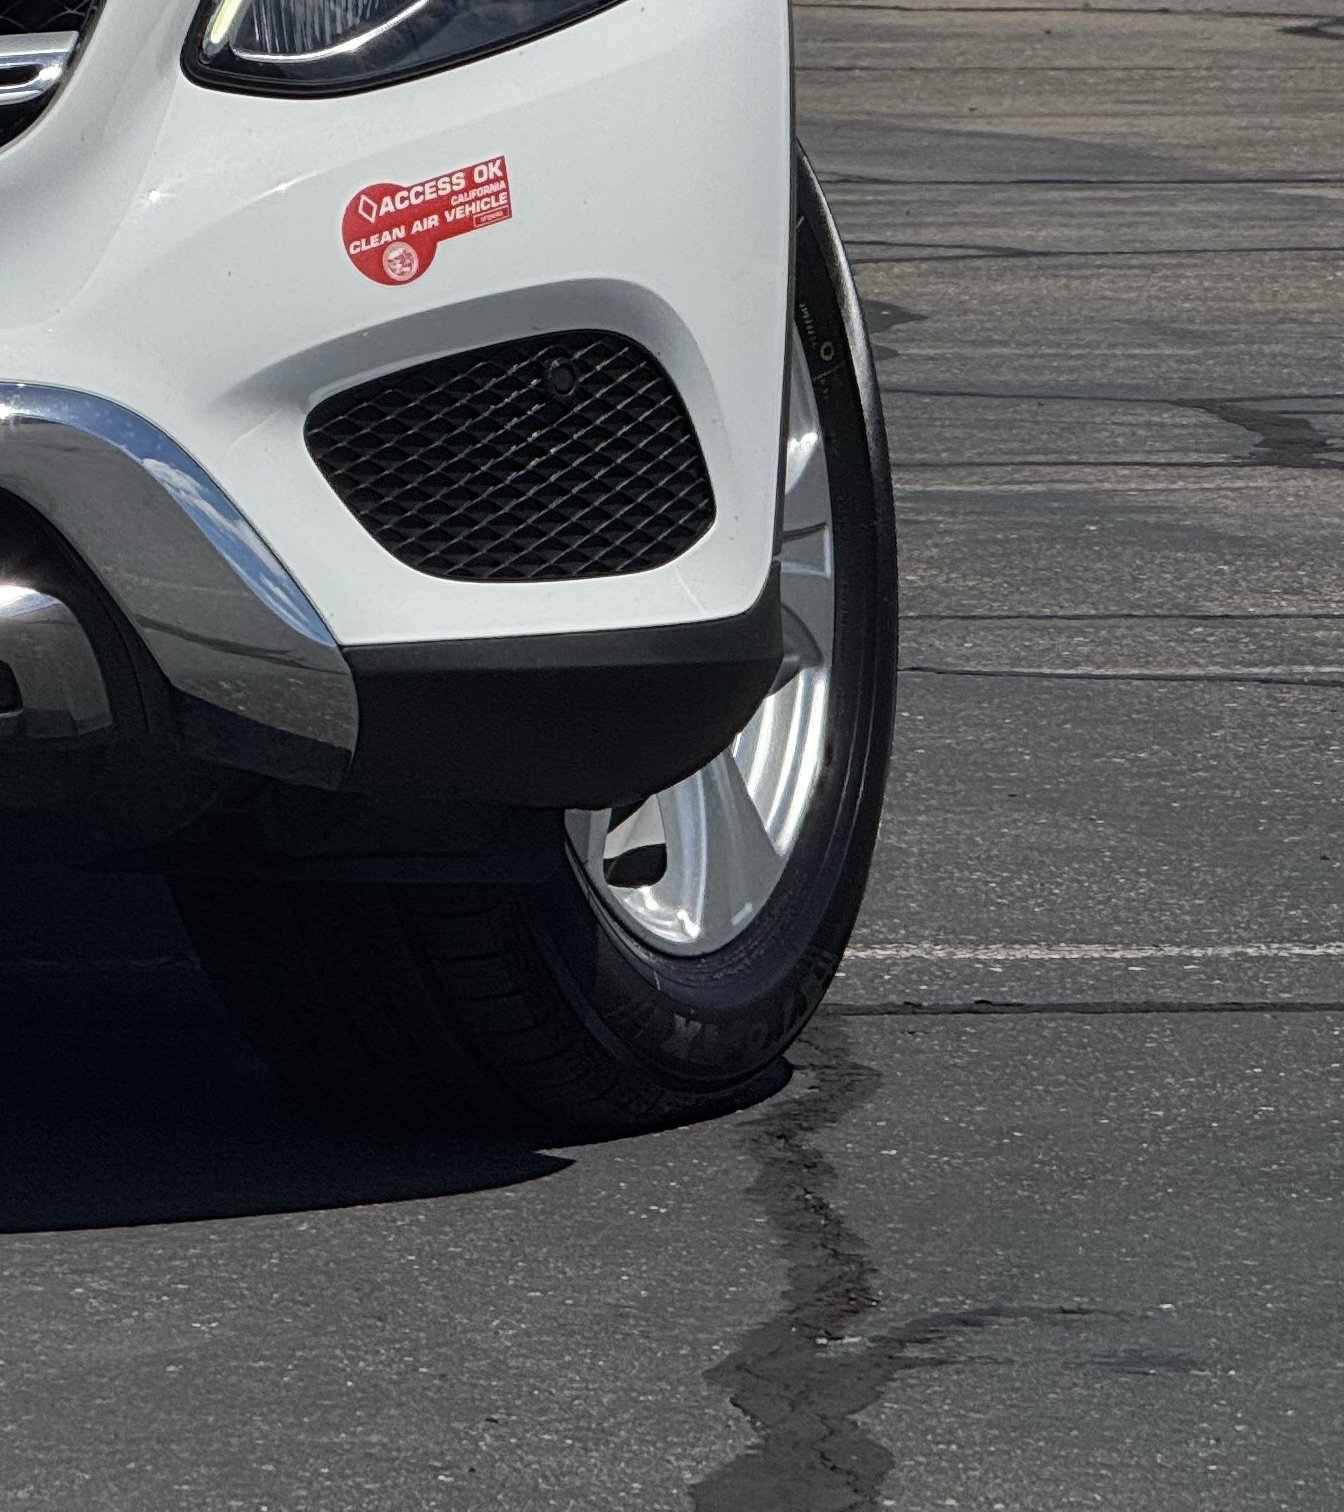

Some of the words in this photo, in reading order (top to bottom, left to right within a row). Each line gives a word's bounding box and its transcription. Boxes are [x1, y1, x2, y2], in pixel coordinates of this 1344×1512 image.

[379, 172, 466, 217] ACCESS
[473, 160, 503, 184] OK
[450, 181, 507, 206] CALIFORNIA
[349, 225, 406, 255] CLEAN
[411, 214, 440, 234] AIR
[444, 192, 508, 223] VEHICLE
